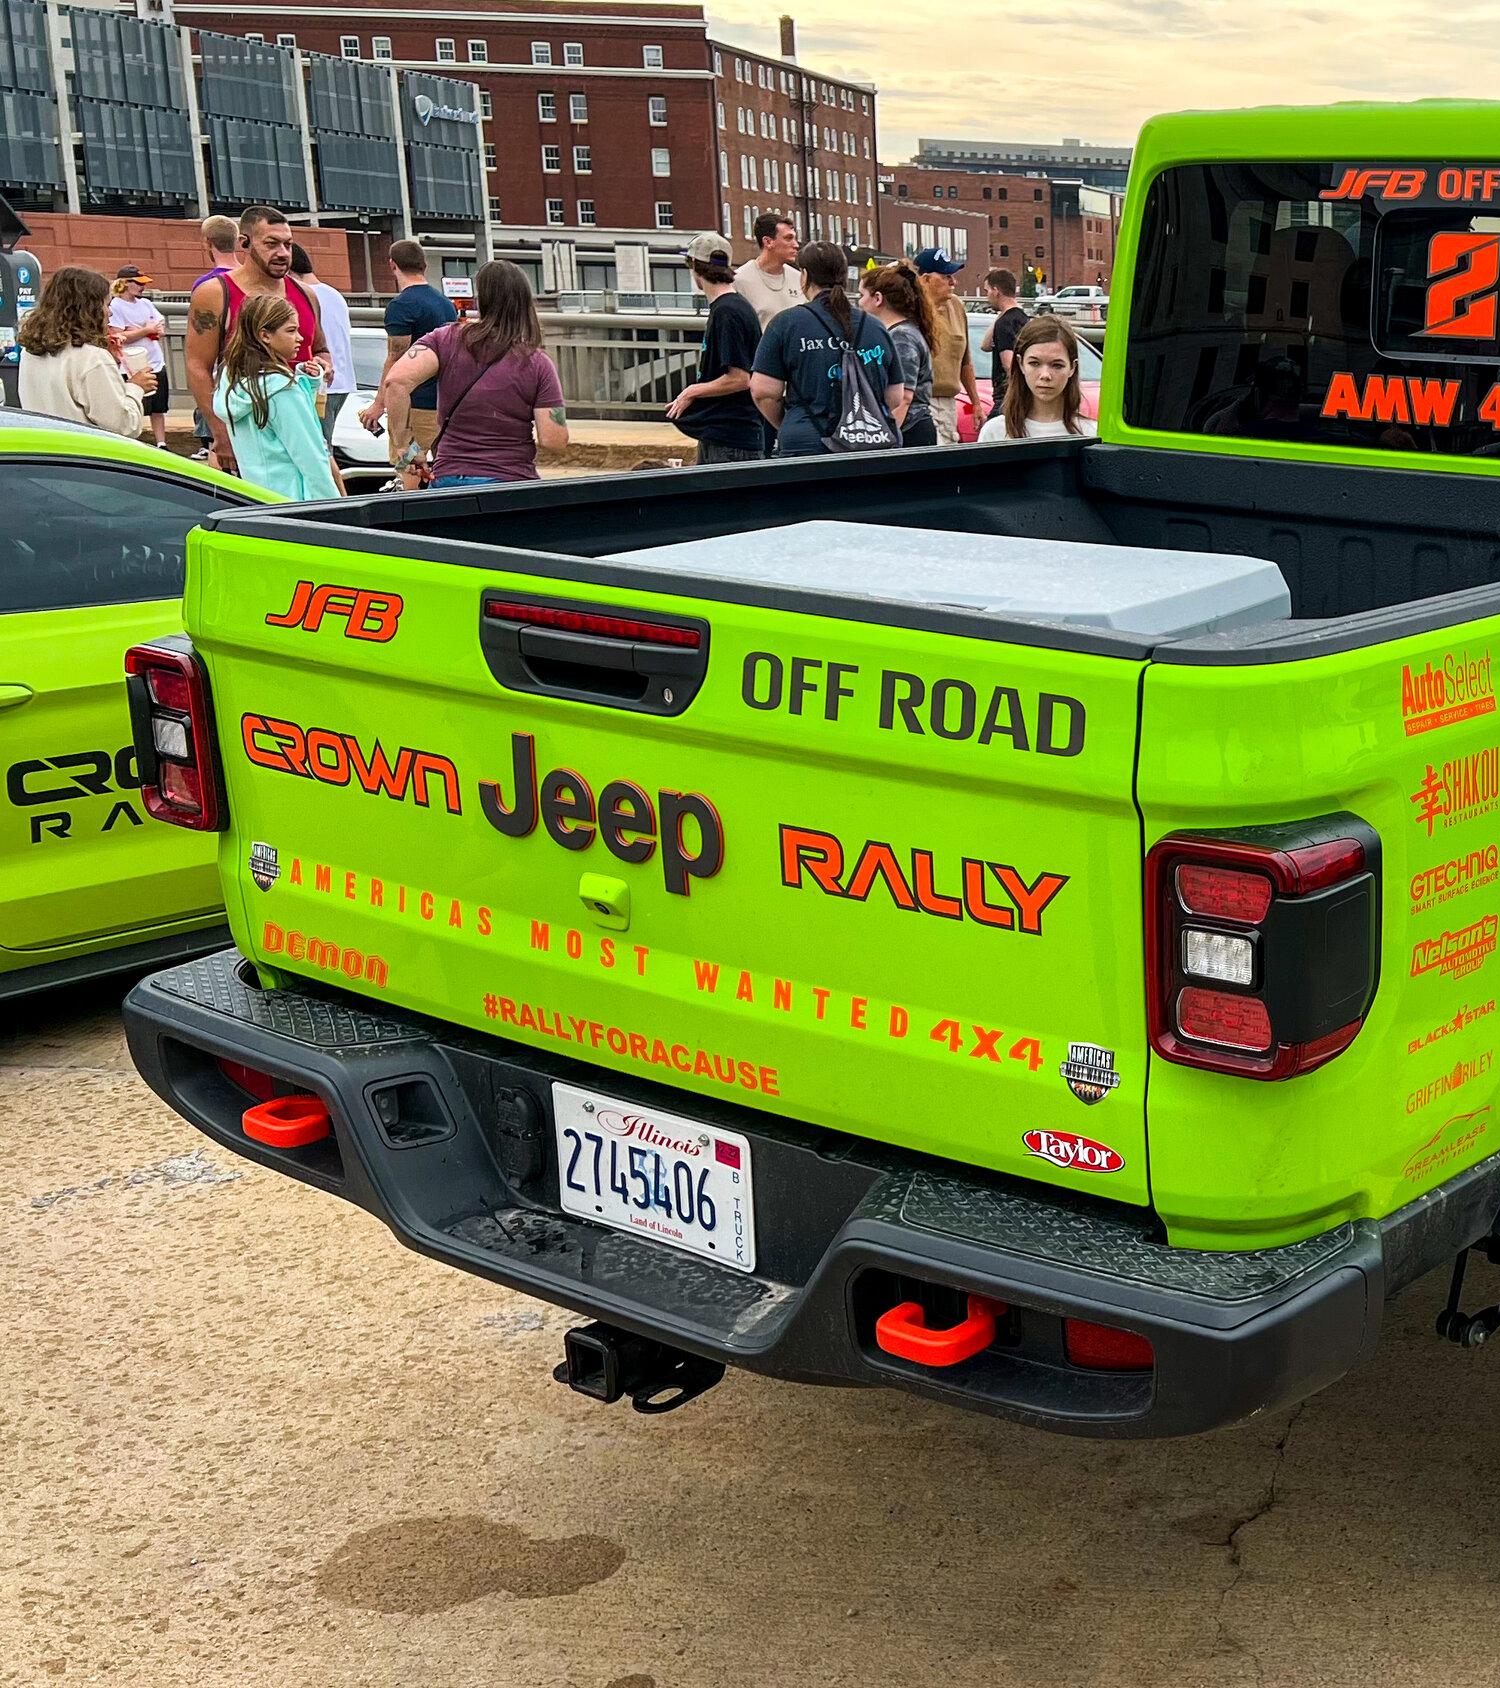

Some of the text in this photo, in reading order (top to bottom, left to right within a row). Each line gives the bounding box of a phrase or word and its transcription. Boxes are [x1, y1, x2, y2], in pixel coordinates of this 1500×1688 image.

[1318, 167, 1429, 200] JFB
[17, 294, 36, 303] HERE
[19, 287, 32, 295] PAY
[800, 337, 824, 352] Jax
[1320, 371, 1462, 427] AMW
[839, 426, 891, 443] Reebok
[265, 579, 404, 643] JFB
[741, 651, 1087, 758] OFF ROAD
[240, 711, 463, 816] CROWN
[1443, 746, 1500, 815] SHAKOU
[478, 731, 725, 897] Jeep
[778, 823, 1070, 936] RALLY
[1410, 844, 1499, 901] GTECHNIQ
[1410, 899, 1435, 916] SMART
[1438, 883, 1469, 904] SURFACE
[289, 857, 1045, 1072] AMERICAS MOST WANTED 4X4
[1440, 939, 1497, 976] AUTOMOTIVE
[482, 991, 782, 1097] #RALLYFORACAUSE
[1407, 999, 1496, 1055] BLACK STAR
[1071, 1046, 1112, 1069] AMERICAS
[1405, 1050, 1493, 1115] GRIFFIN RILEY
[597, 1110, 703, 1157] Illinois
[1028, 1130, 1112, 1168] Taylor
[563, 1128, 716, 1231] 2745406
[629, 1213, 648, 1229] Land
[657, 1224, 683, 1240] Lincoln
[732, 1172, 744, 1262] B TRUCK
